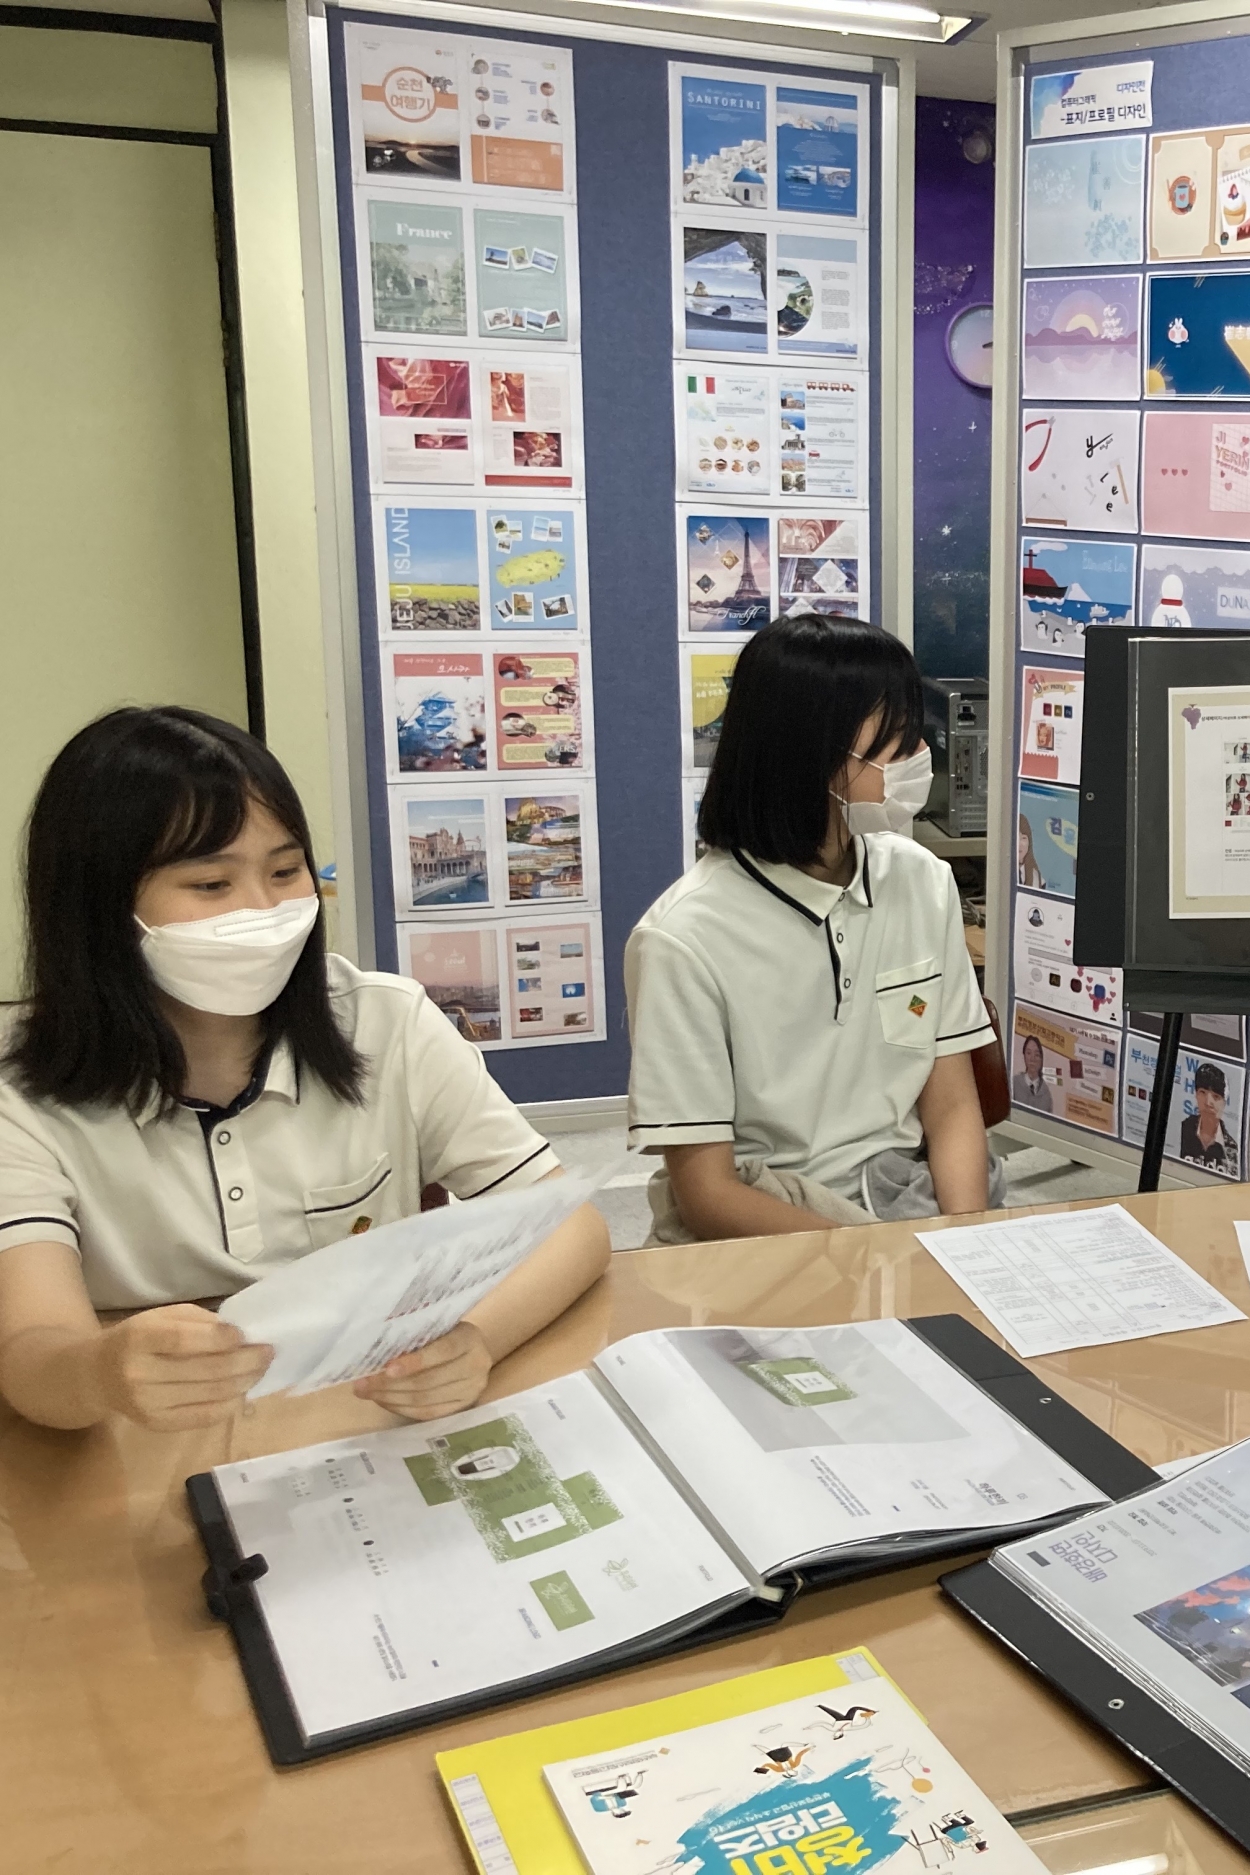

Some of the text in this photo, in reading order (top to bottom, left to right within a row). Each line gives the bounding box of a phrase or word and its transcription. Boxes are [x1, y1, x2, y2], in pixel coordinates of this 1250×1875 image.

[396, 76, 423, 93] 순천
[390, 94, 431, 111] 여행기
[687, 91, 762, 110] SANTORINI
[1061, 94, 1097, 108] 컴퓨터그래픽
[1117, 103, 1146, 119] 디자인
[395, 222, 453, 240] France
[1215, 445, 1250, 471] YERIN
[391, 508, 415, 630] JEJU ISLAND
[1071, 1530, 1118, 1564] 디자인
[1048, 1540, 1108, 1583] 배경화면
[713, 1800, 848, 1860] 타임즈
